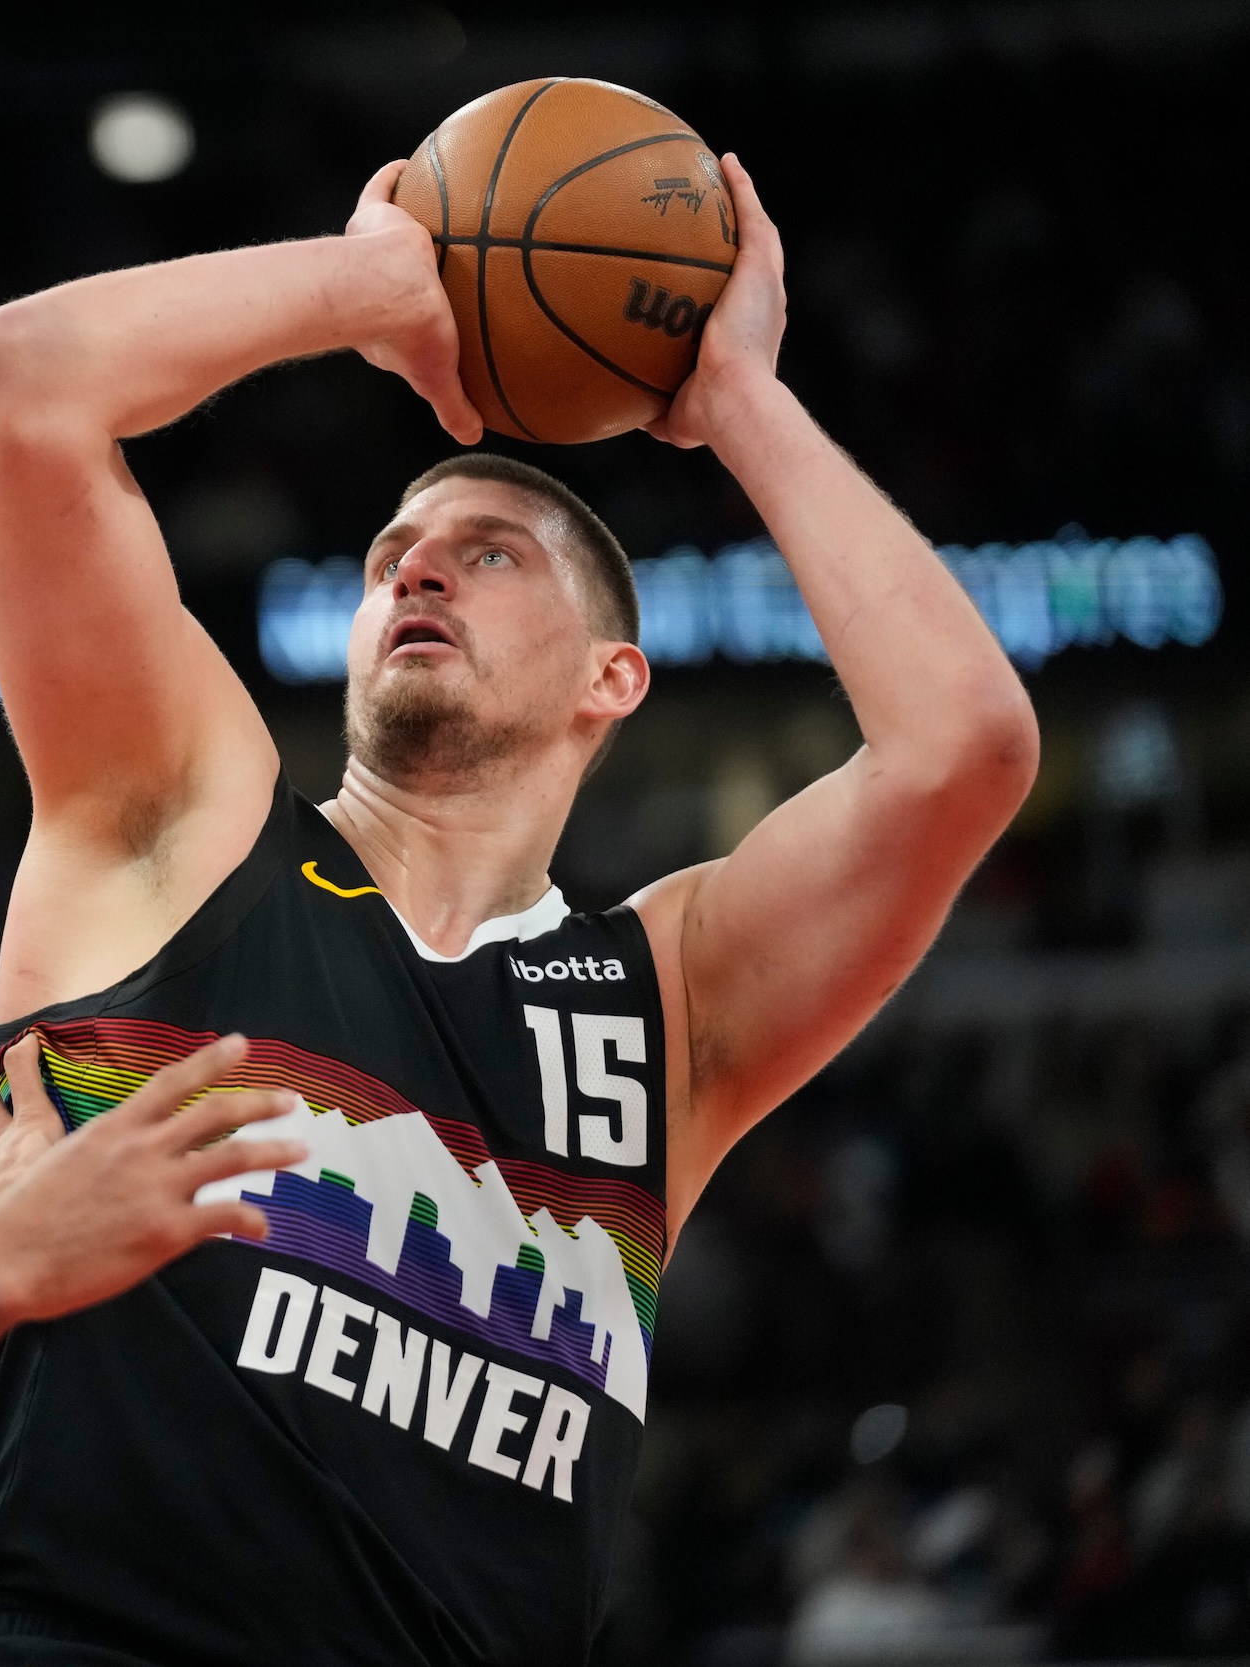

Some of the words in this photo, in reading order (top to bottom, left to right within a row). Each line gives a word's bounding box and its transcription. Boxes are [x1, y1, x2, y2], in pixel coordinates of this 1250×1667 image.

[508, 954, 627, 983] ibotta
[523, 1003, 647, 1167] 15
[236, 1266, 592, 1504] DENVER
